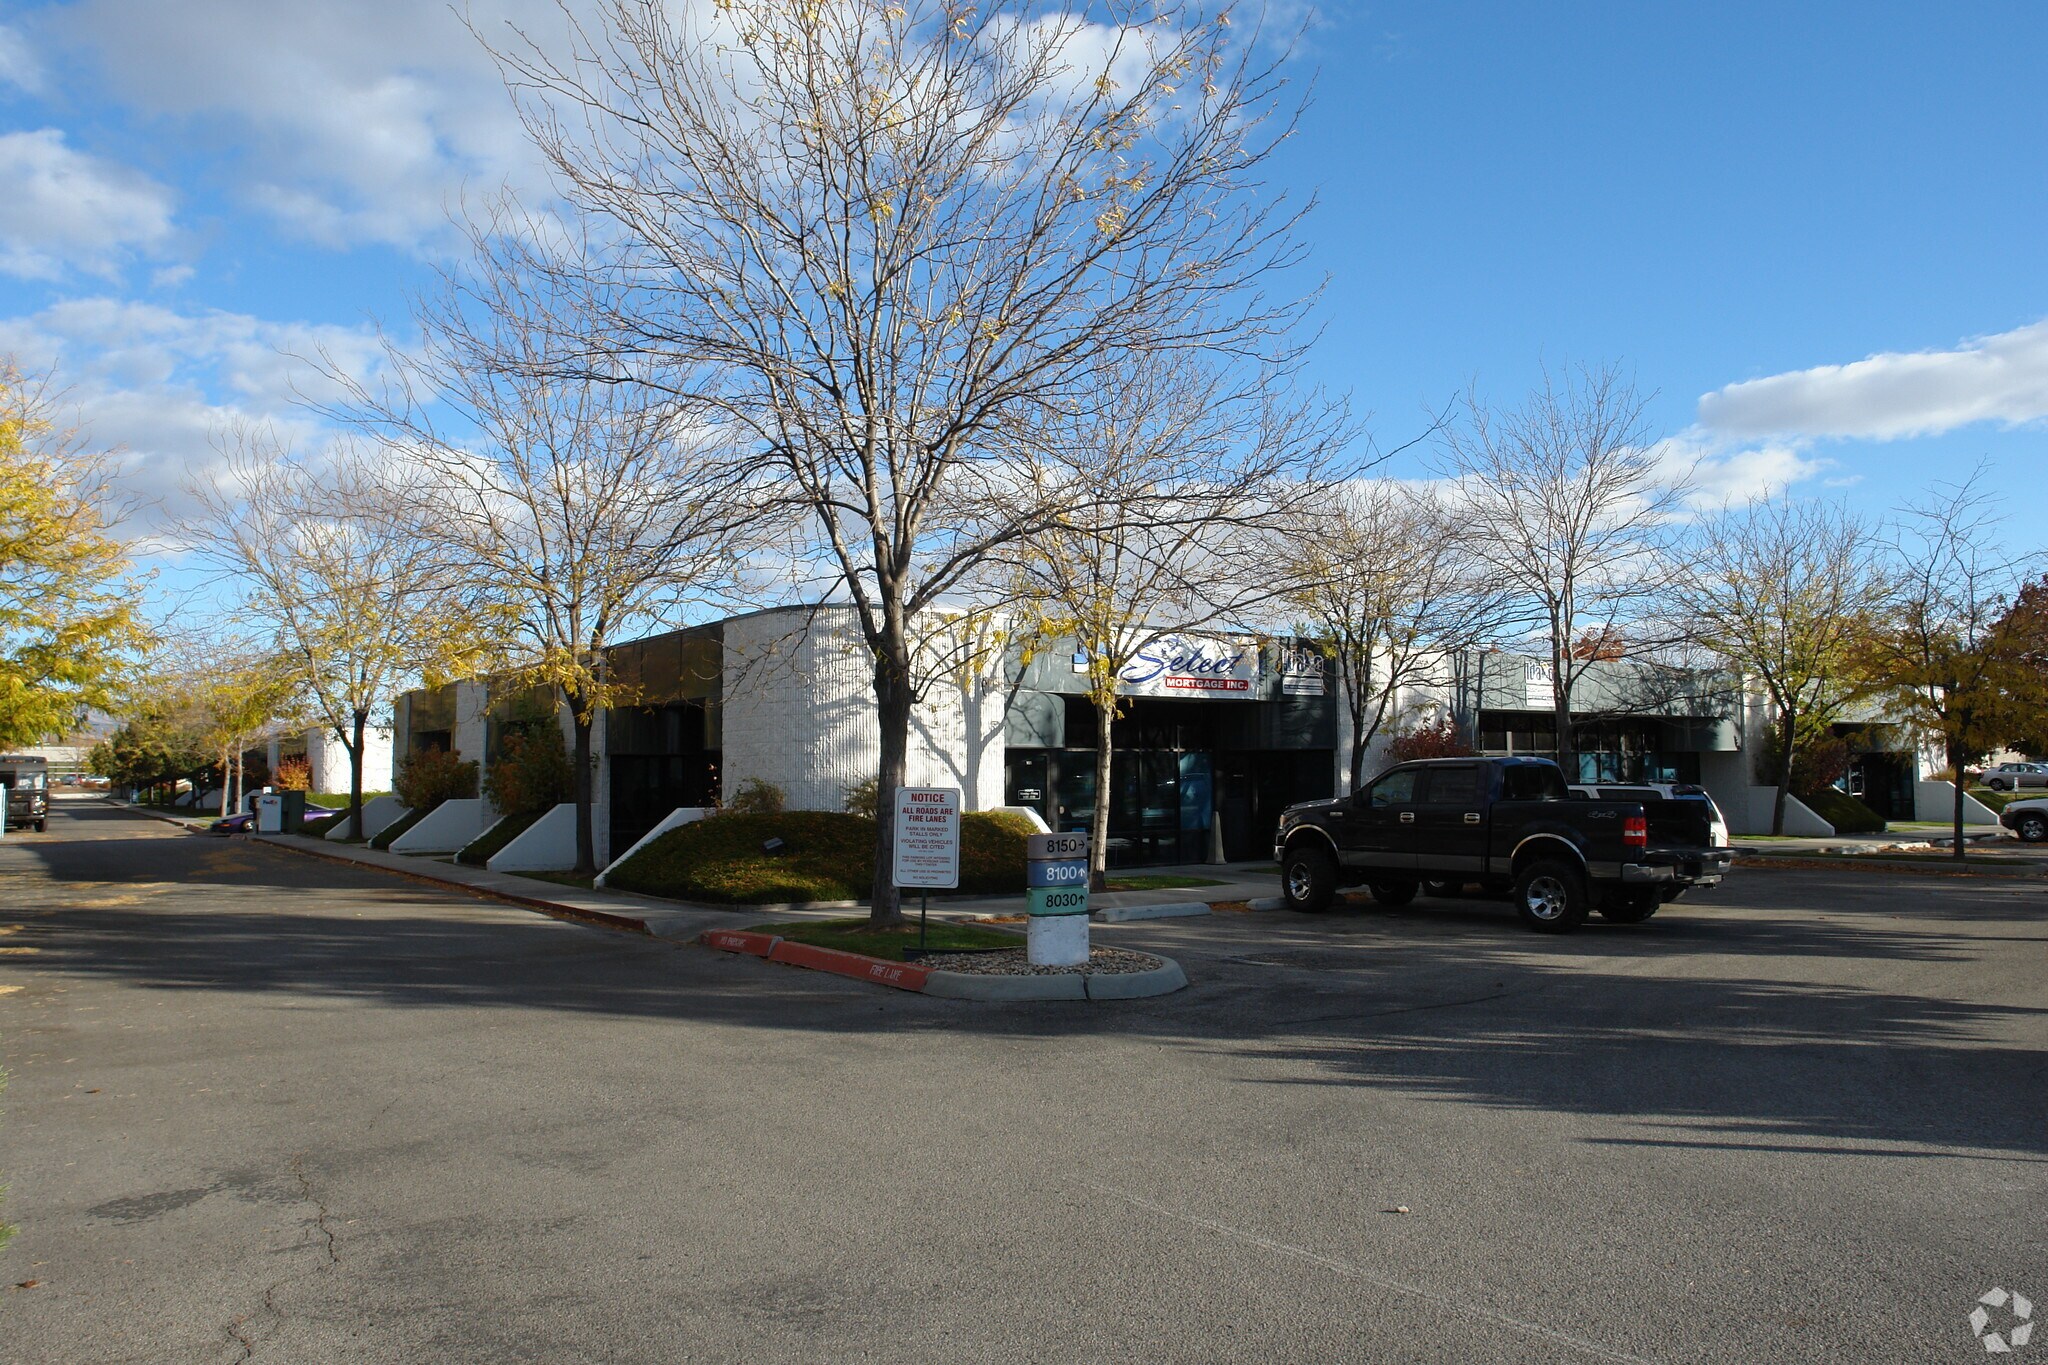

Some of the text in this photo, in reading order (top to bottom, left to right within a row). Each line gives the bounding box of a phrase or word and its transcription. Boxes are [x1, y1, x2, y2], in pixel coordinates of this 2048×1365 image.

[1120, 638, 1243, 684] Select
[1166, 678, 1248, 689] MORTGAGE INC.
[911, 793, 945, 803] NOTICE
[902, 807, 953, 816] ALL ROADS ARE
[925, 815, 947, 823] LANES
[1047, 839, 1077, 853] 8150
[1046, 866, 1077, 881] 8100
[1046, 893, 1077, 908] 8030
[869, 964, 903, 981] FIRE LANE
